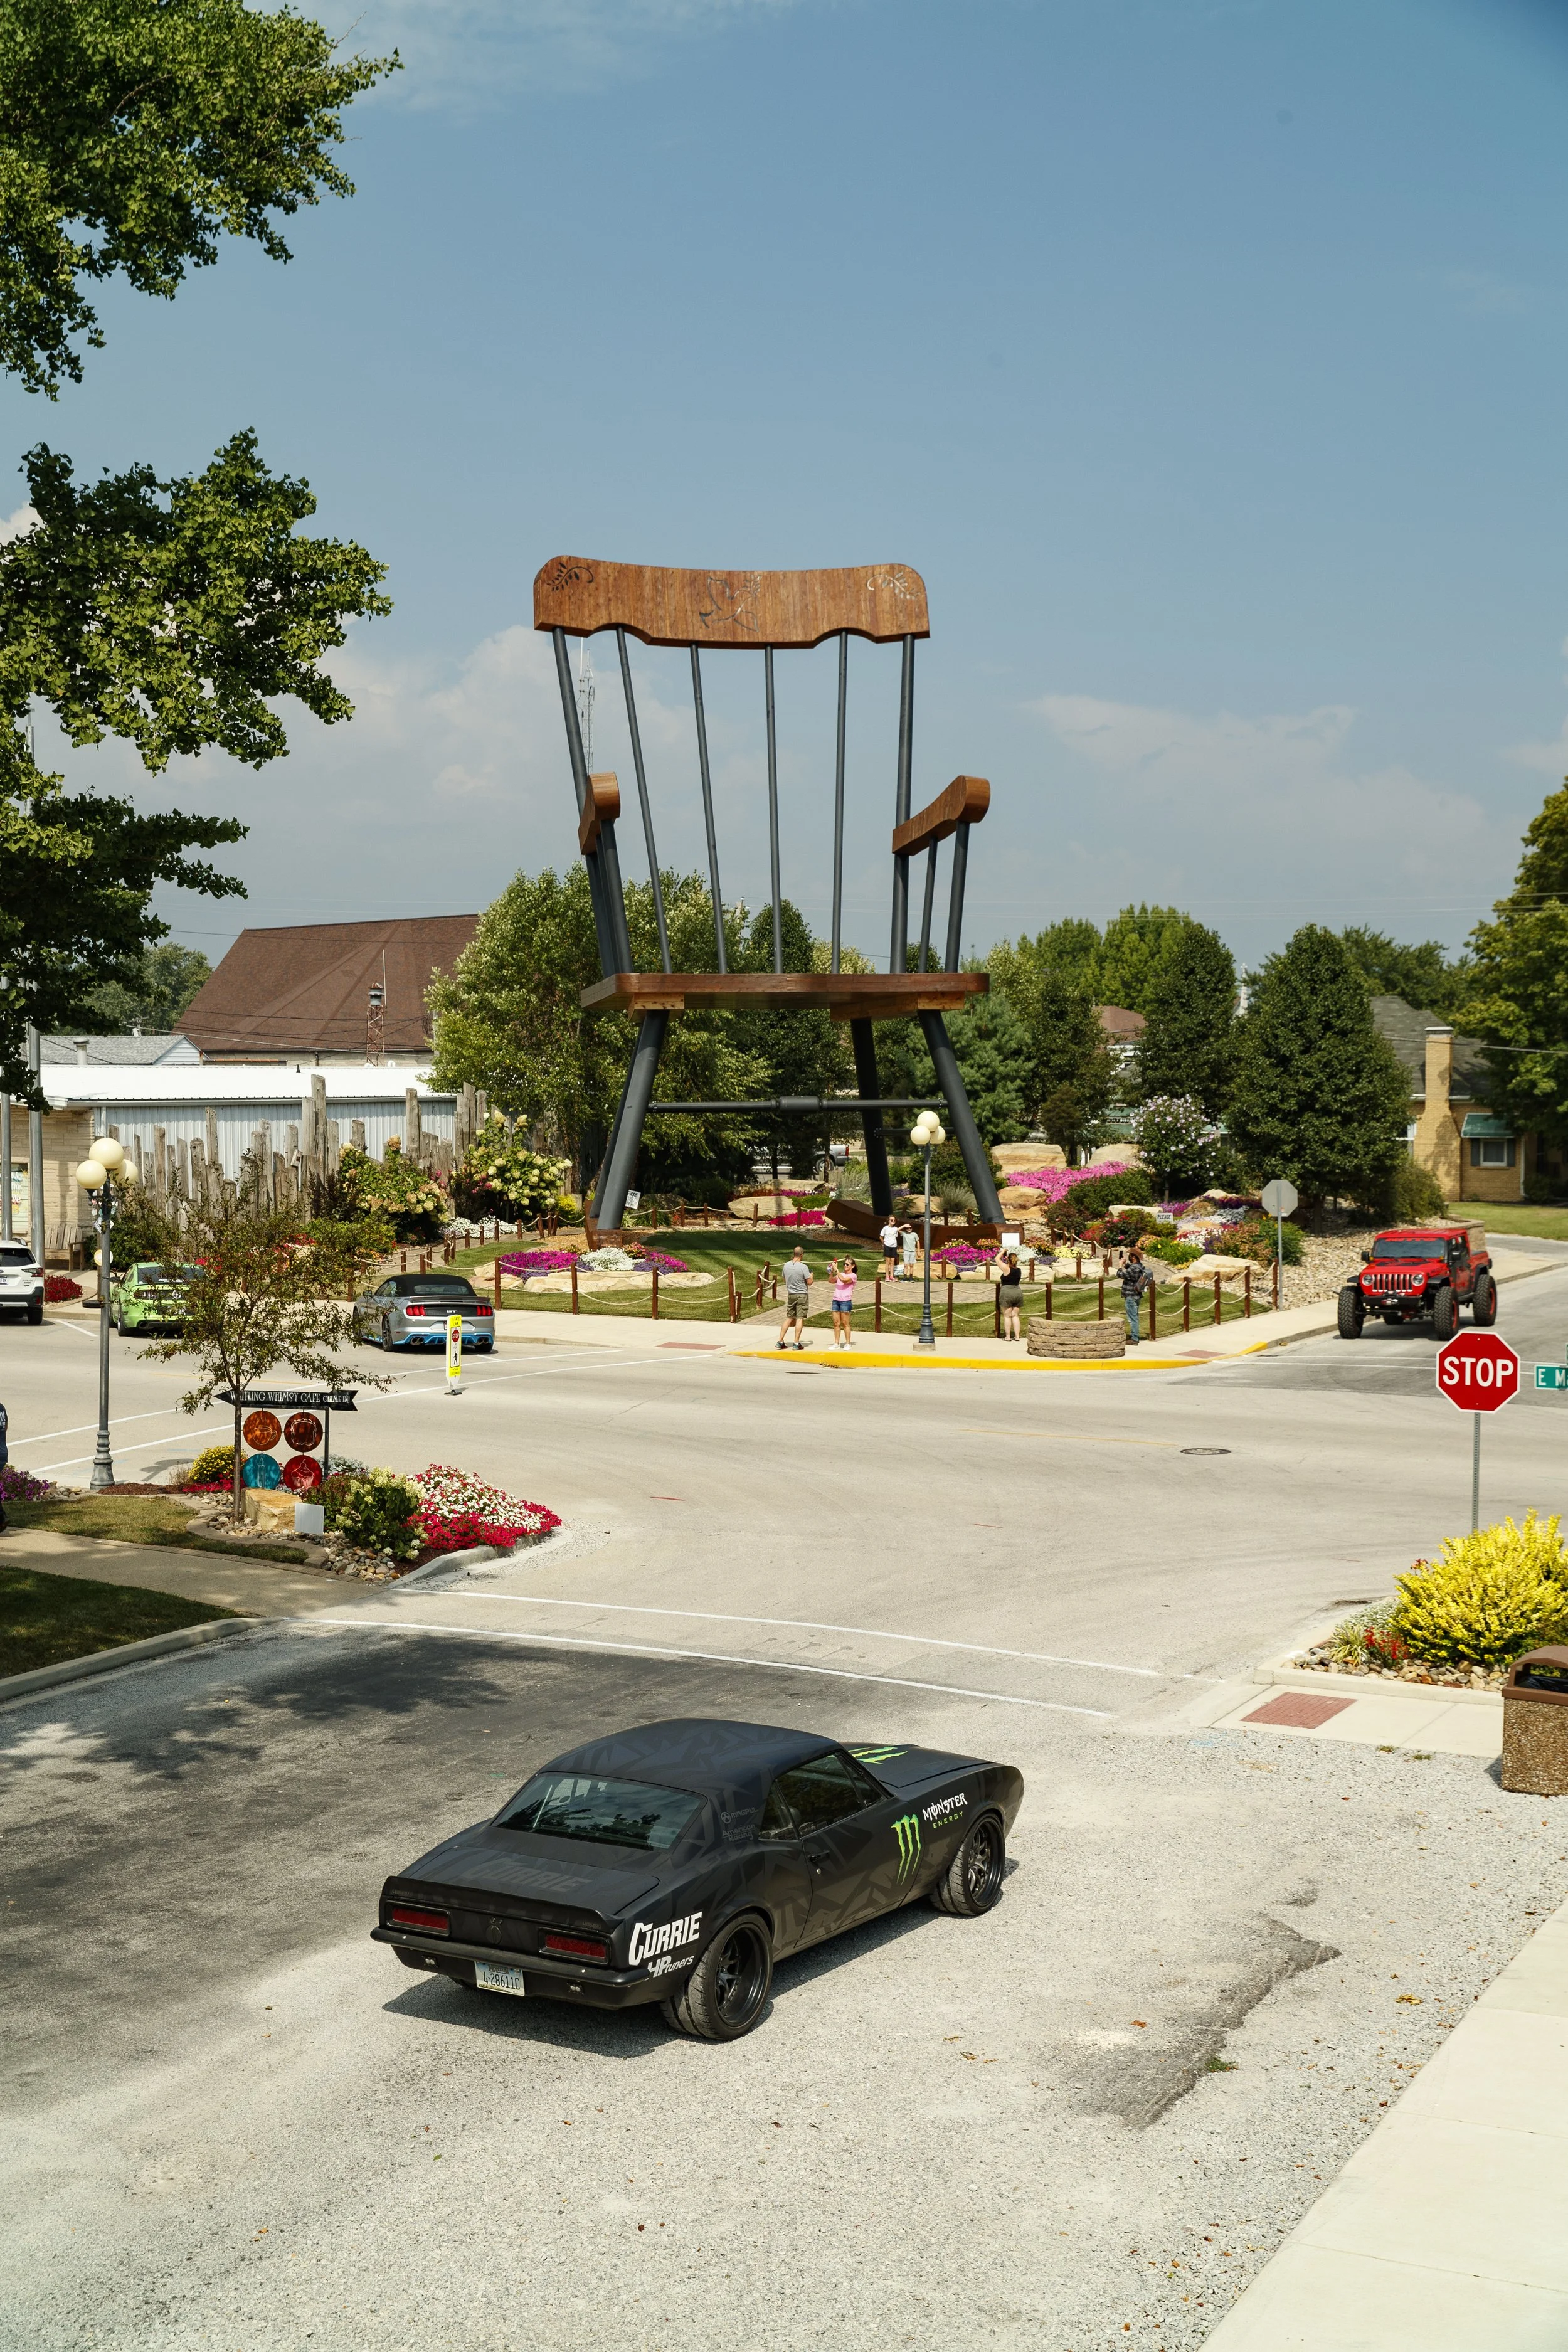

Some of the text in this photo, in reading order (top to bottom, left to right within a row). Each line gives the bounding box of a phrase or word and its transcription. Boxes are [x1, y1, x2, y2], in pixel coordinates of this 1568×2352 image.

[1443, 1356, 1514, 1387] STOP
[1538, 1369, 1568, 1387] E M
[268, 1391, 299, 1402] WHIMSY
[300, 1392, 320, 1403] CAFE
[730, 1807, 758, 1819] MAGPUL
[922, 1793, 968, 1821] MONSTER
[933, 1811, 963, 1829] ENERGY
[722, 1824, 756, 1838] American
[728, 1831, 753, 1841] Racing
[628, 1911, 702, 1966] CURRIE
